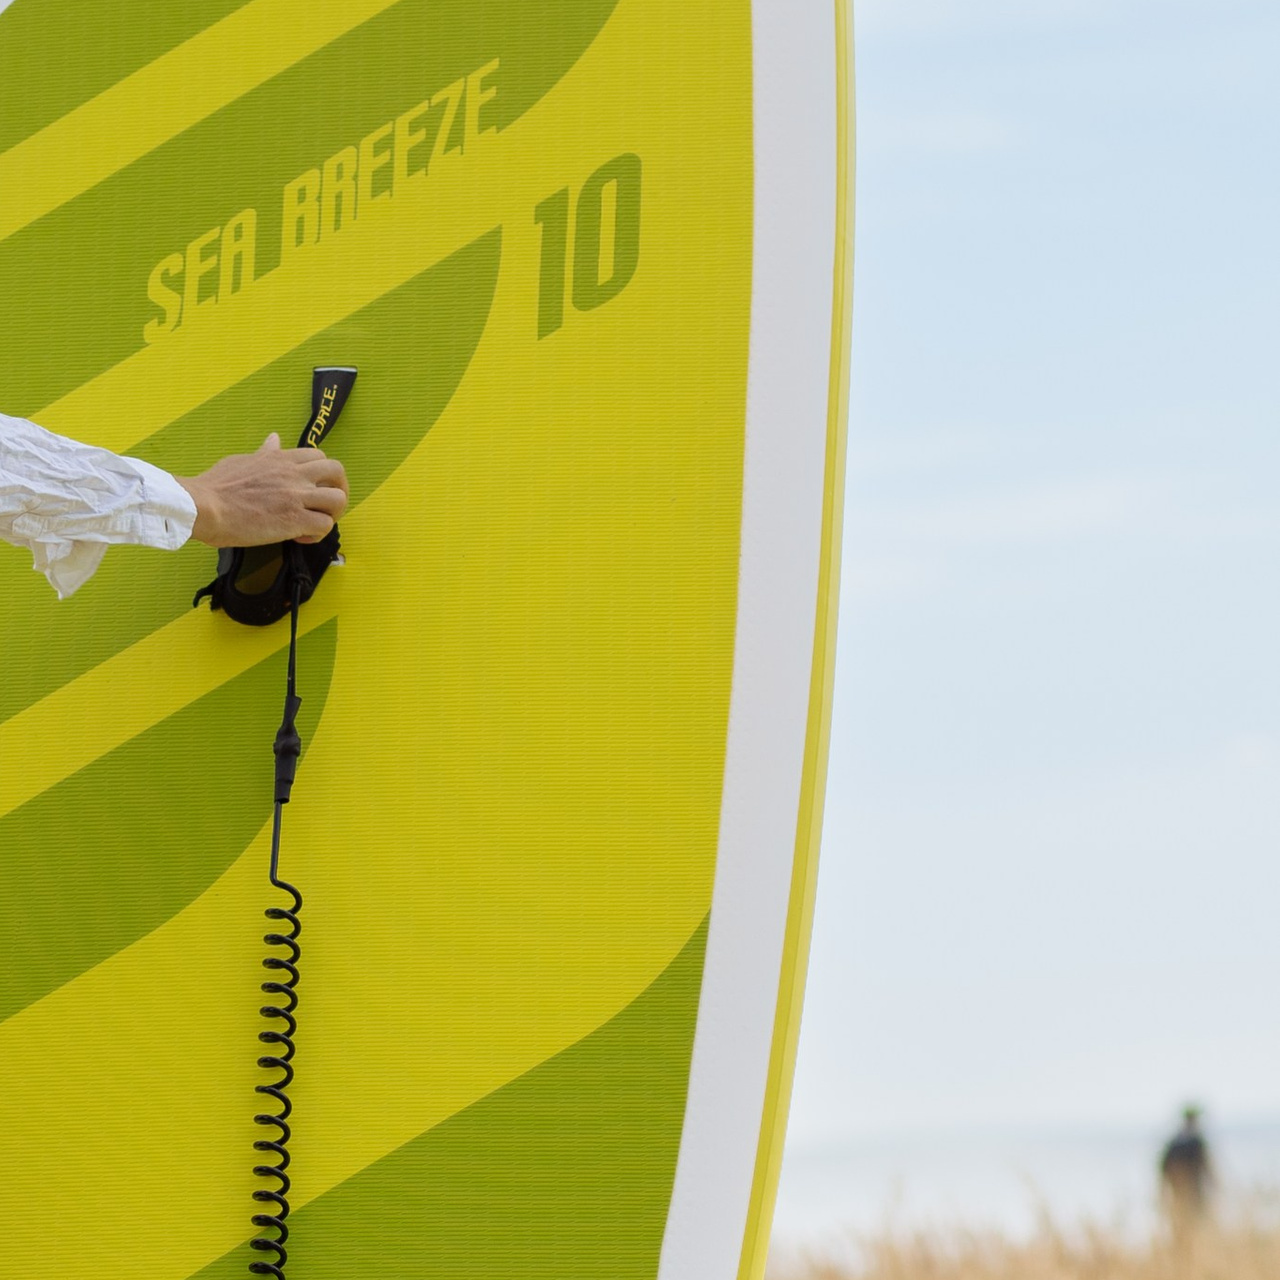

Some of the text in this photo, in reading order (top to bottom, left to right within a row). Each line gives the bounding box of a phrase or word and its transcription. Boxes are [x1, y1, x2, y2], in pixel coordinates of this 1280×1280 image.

[143, 57, 501, 345] SEA BREEZE
[533, 152, 643, 342] 10
